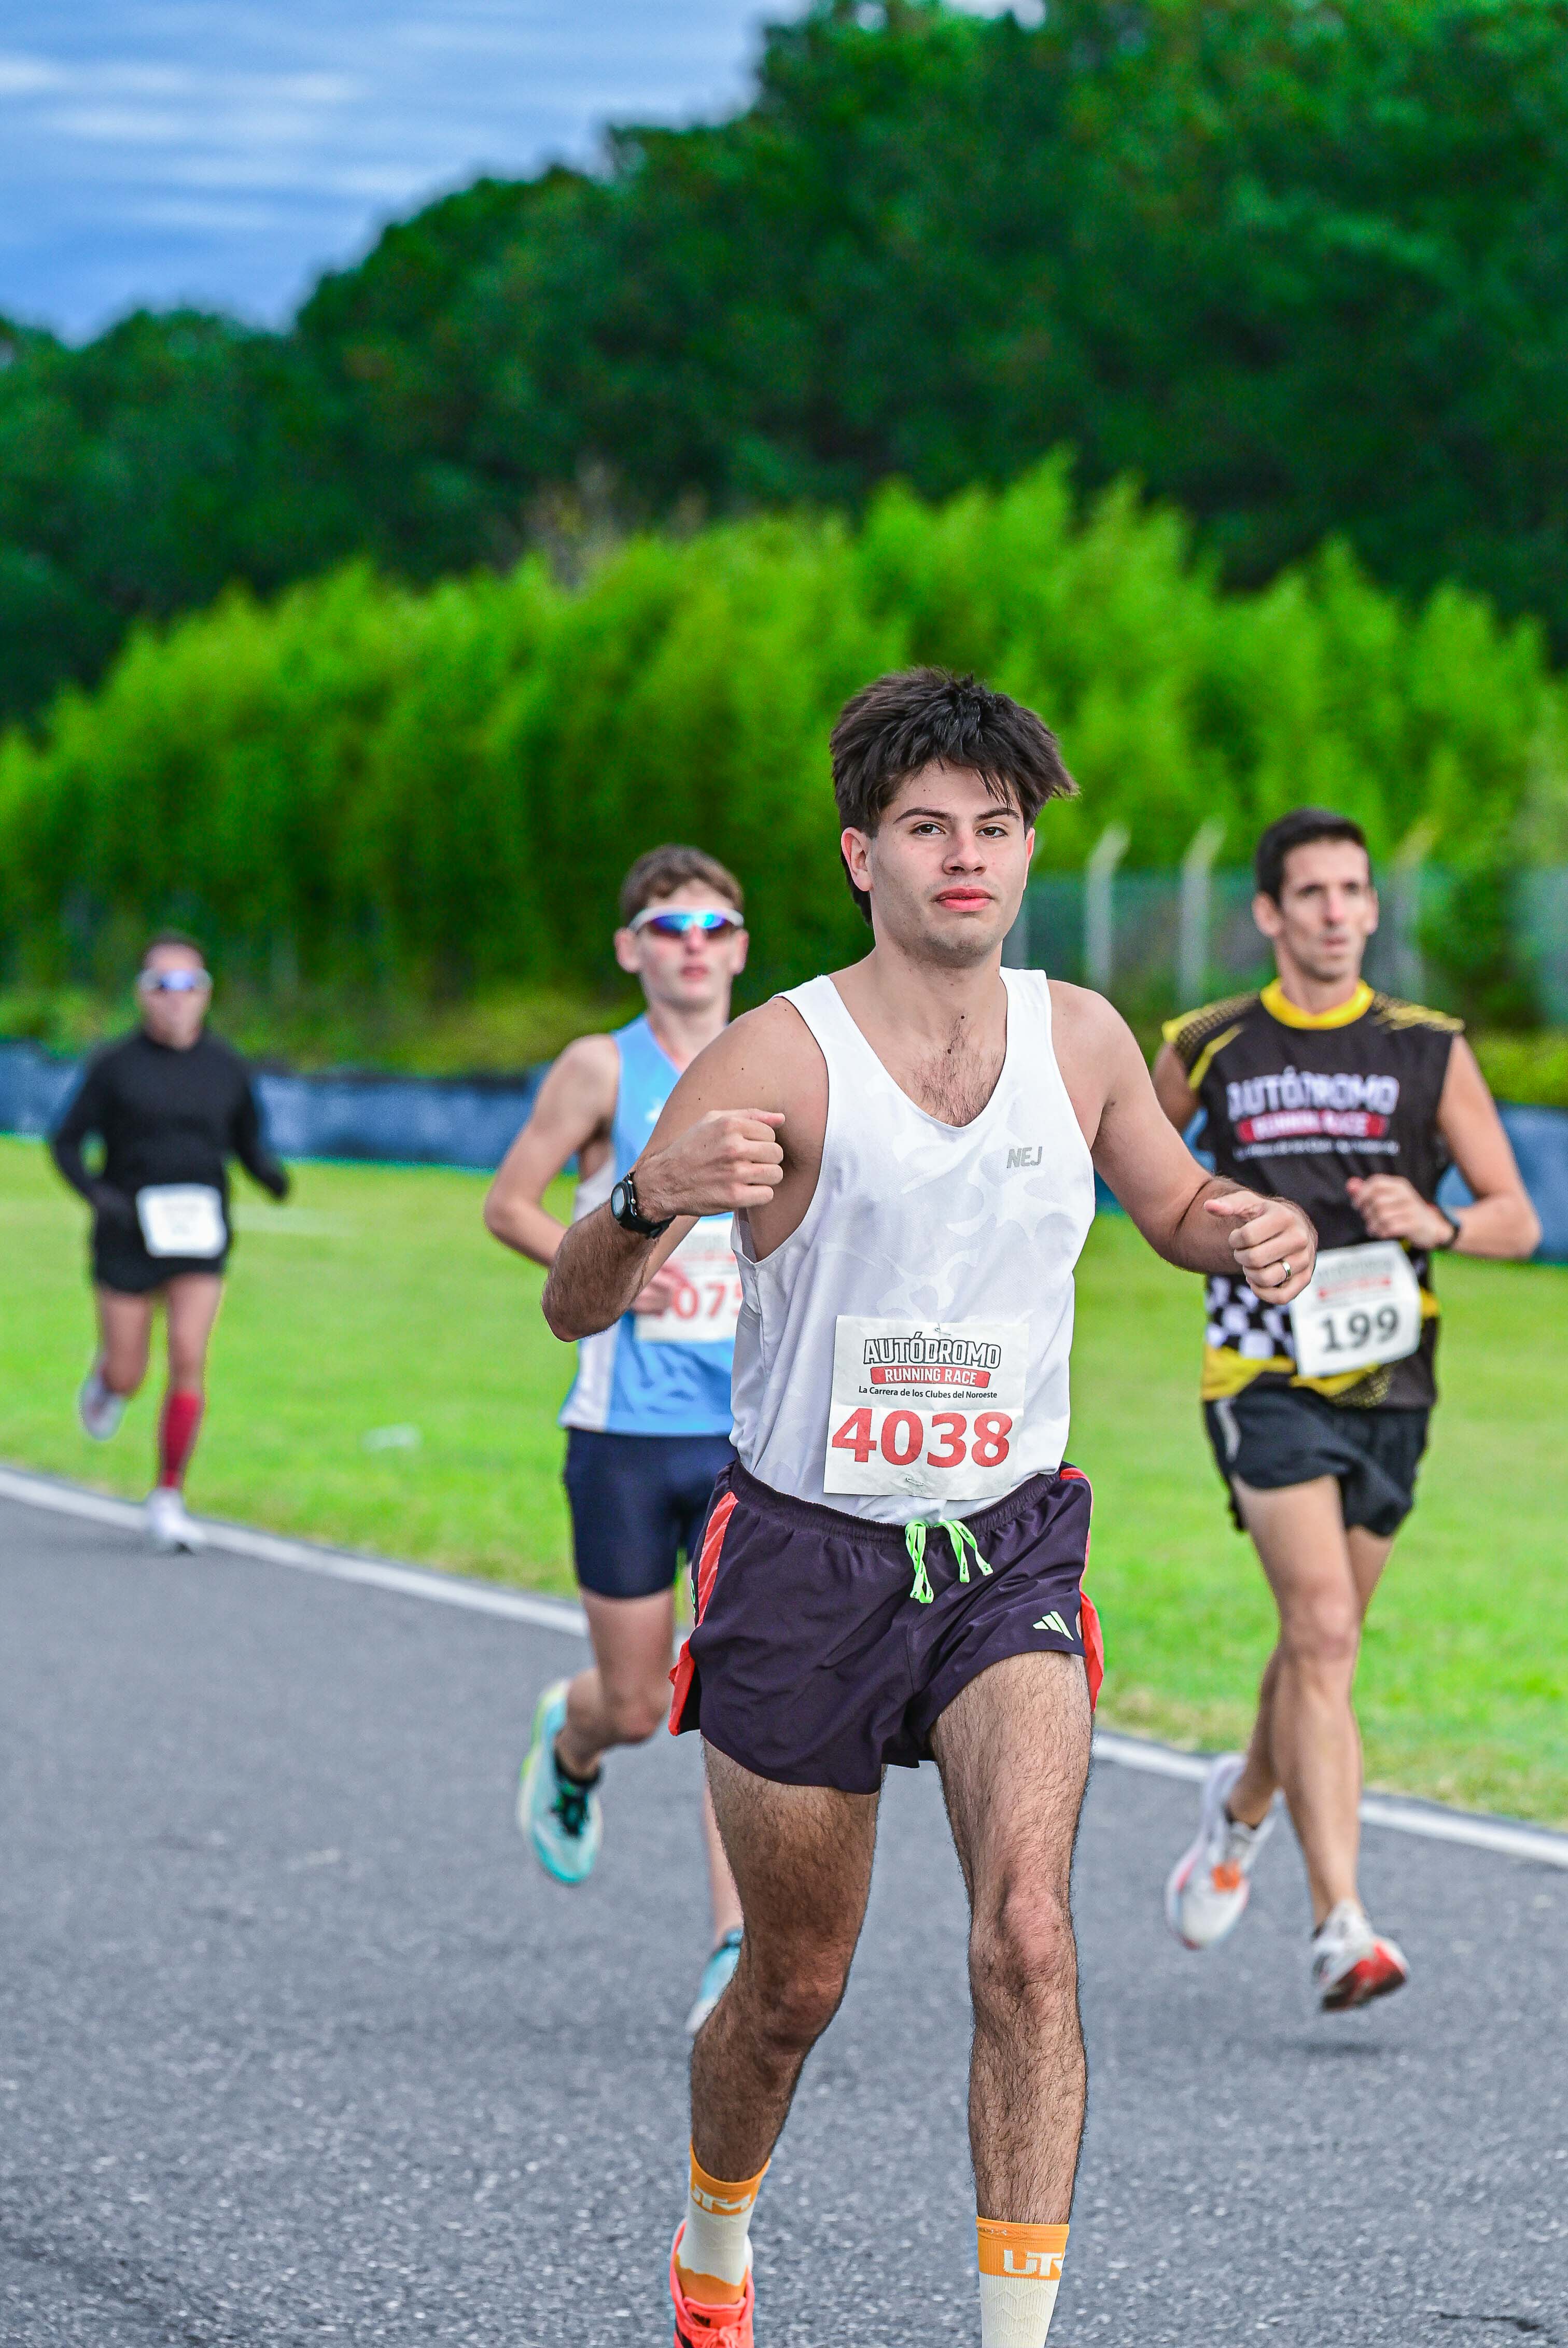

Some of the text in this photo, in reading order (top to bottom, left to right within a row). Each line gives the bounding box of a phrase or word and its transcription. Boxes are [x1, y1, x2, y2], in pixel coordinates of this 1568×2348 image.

[1006, 1146, 1042, 1168] NEJ
[673, 1282, 743, 1320] 07
[1320, 1305, 1399, 1353] 199
[863, 1332, 1001, 1369] AUTÓDROMO
[870, 1387, 898, 1395] Carrera
[885, 1367, 977, 1385] RUNNING RACE
[832, 1408, 1013, 1468] 4038
